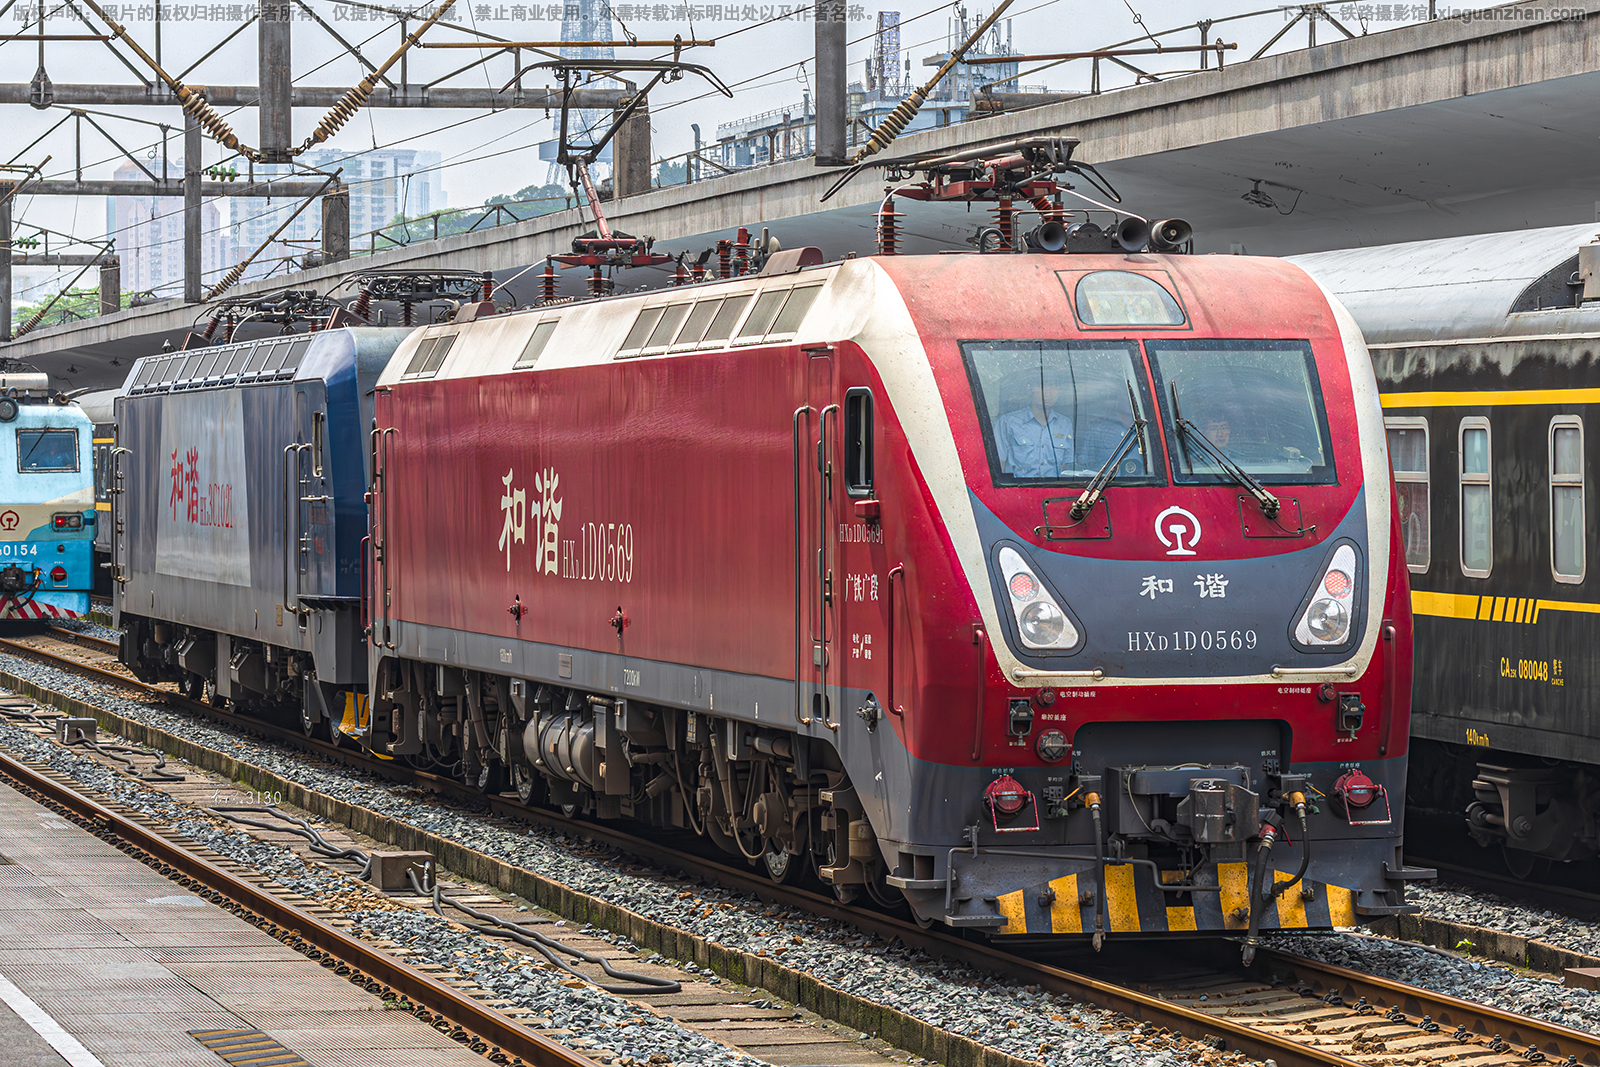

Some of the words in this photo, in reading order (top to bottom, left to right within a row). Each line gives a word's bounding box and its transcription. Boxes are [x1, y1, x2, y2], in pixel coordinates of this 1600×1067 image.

[169, 445, 199, 524] 和谐
[498, 466, 563, 576] 和谐
[1518, 658, 1549, 682] 080048
